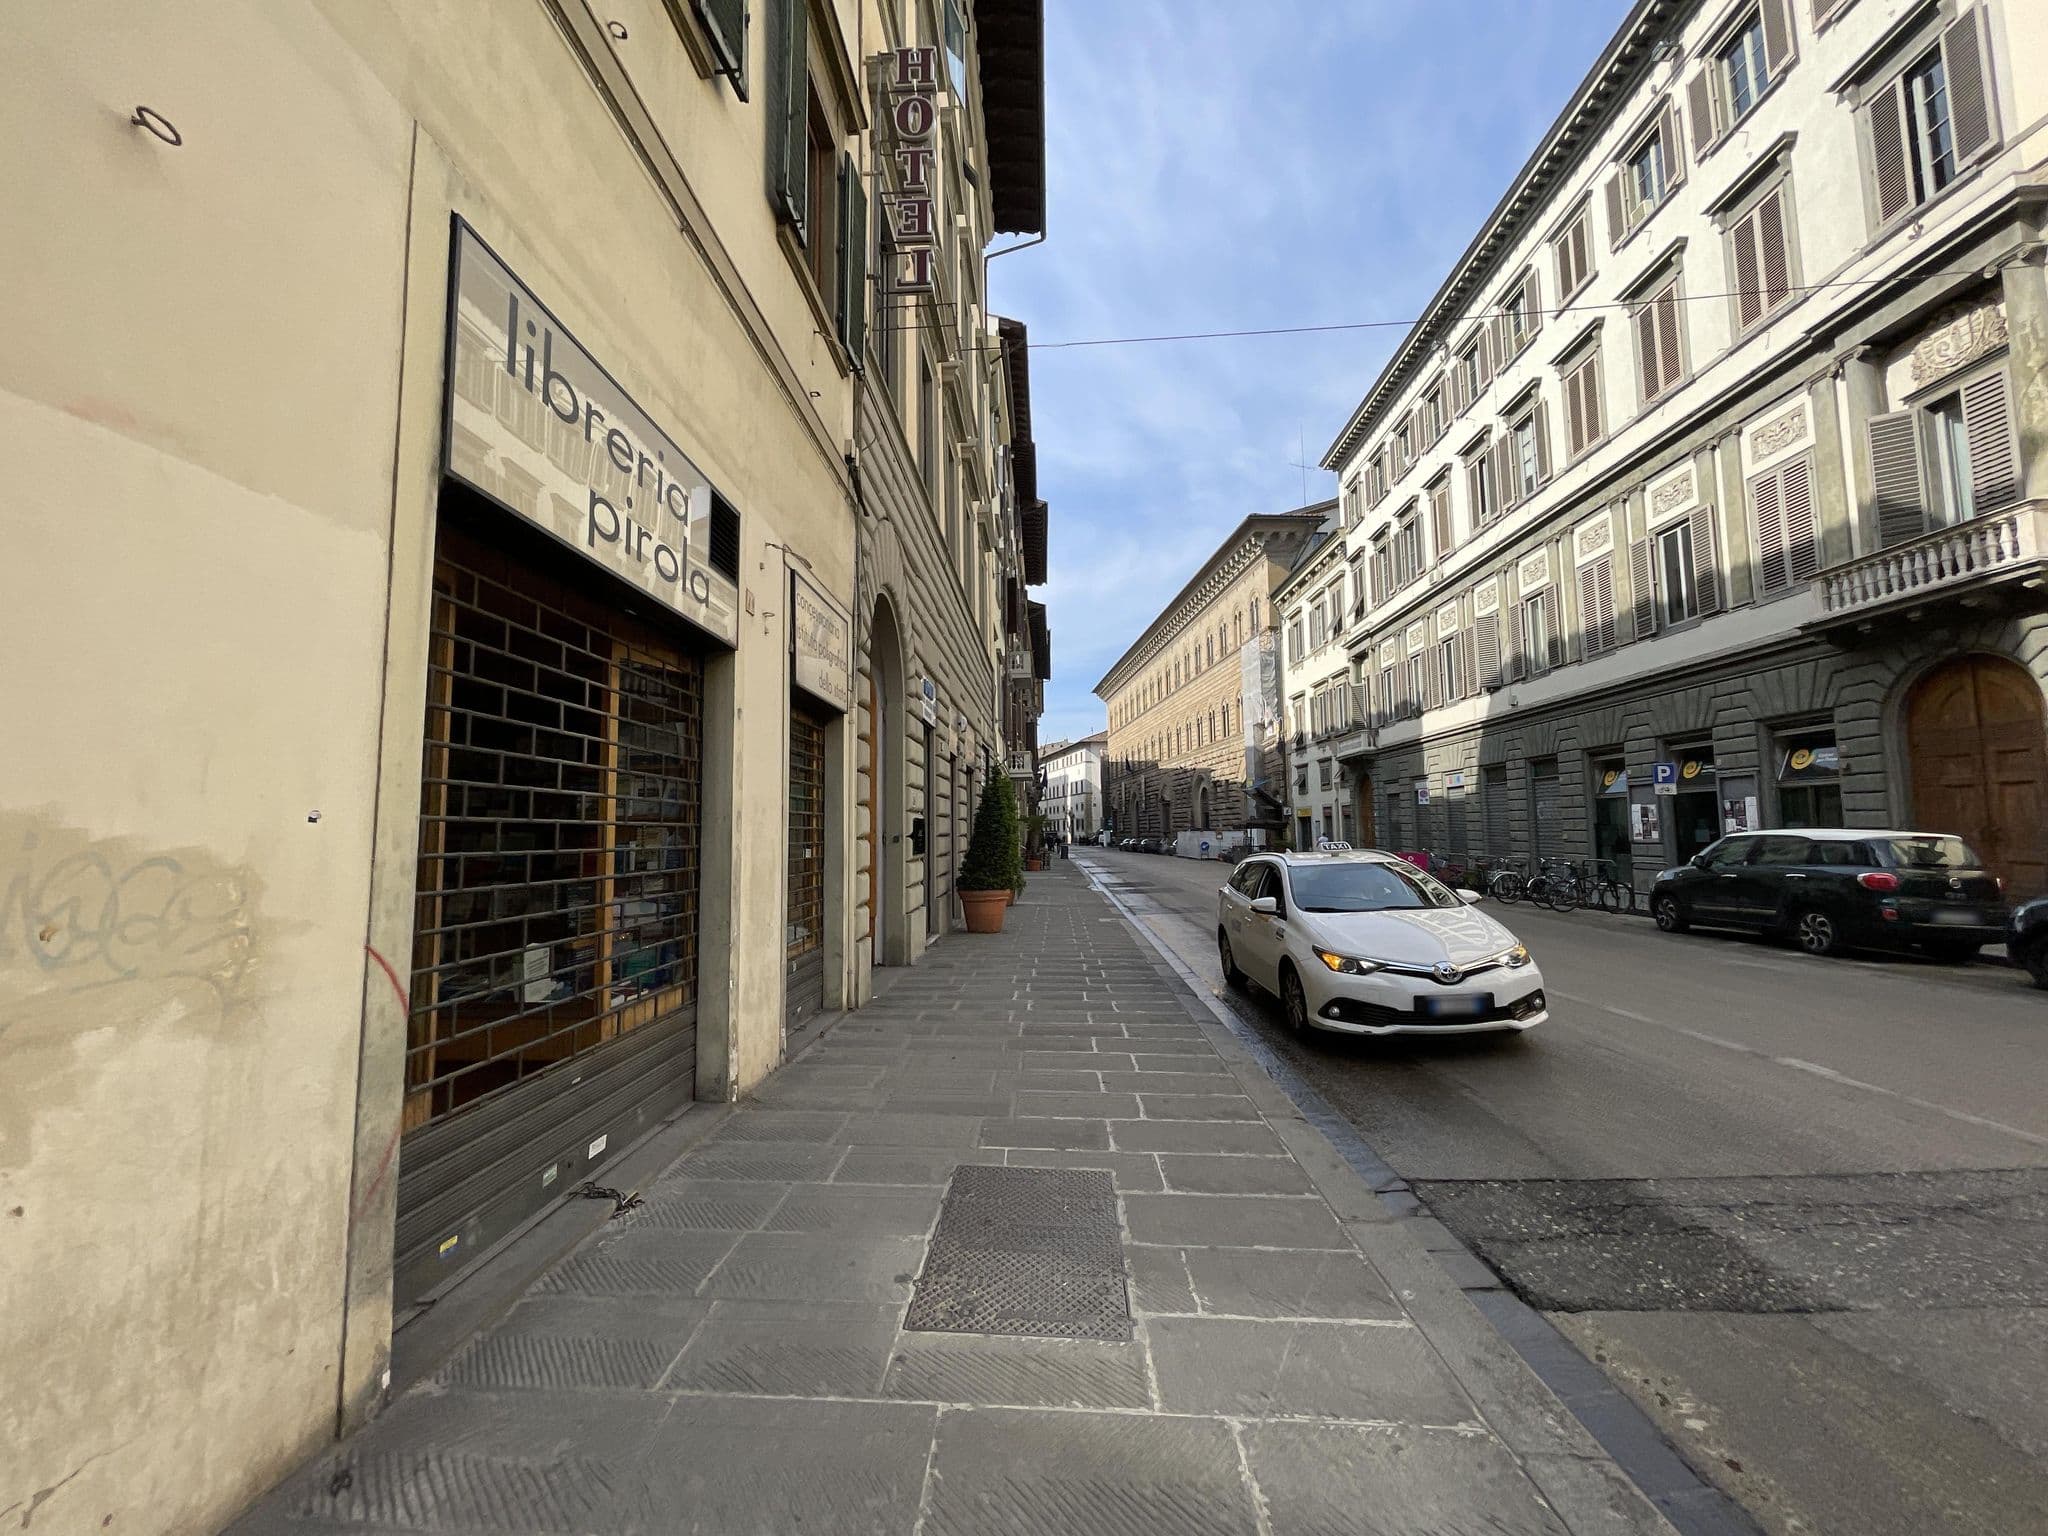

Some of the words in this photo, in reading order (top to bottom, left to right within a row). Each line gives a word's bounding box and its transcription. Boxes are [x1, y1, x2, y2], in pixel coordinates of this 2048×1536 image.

[506, 291, 690, 527] libreria
[588, 488, 710, 610] pirola
[1657, 765, 1671, 783] P
[1323, 842, 1349, 852] TAXI
